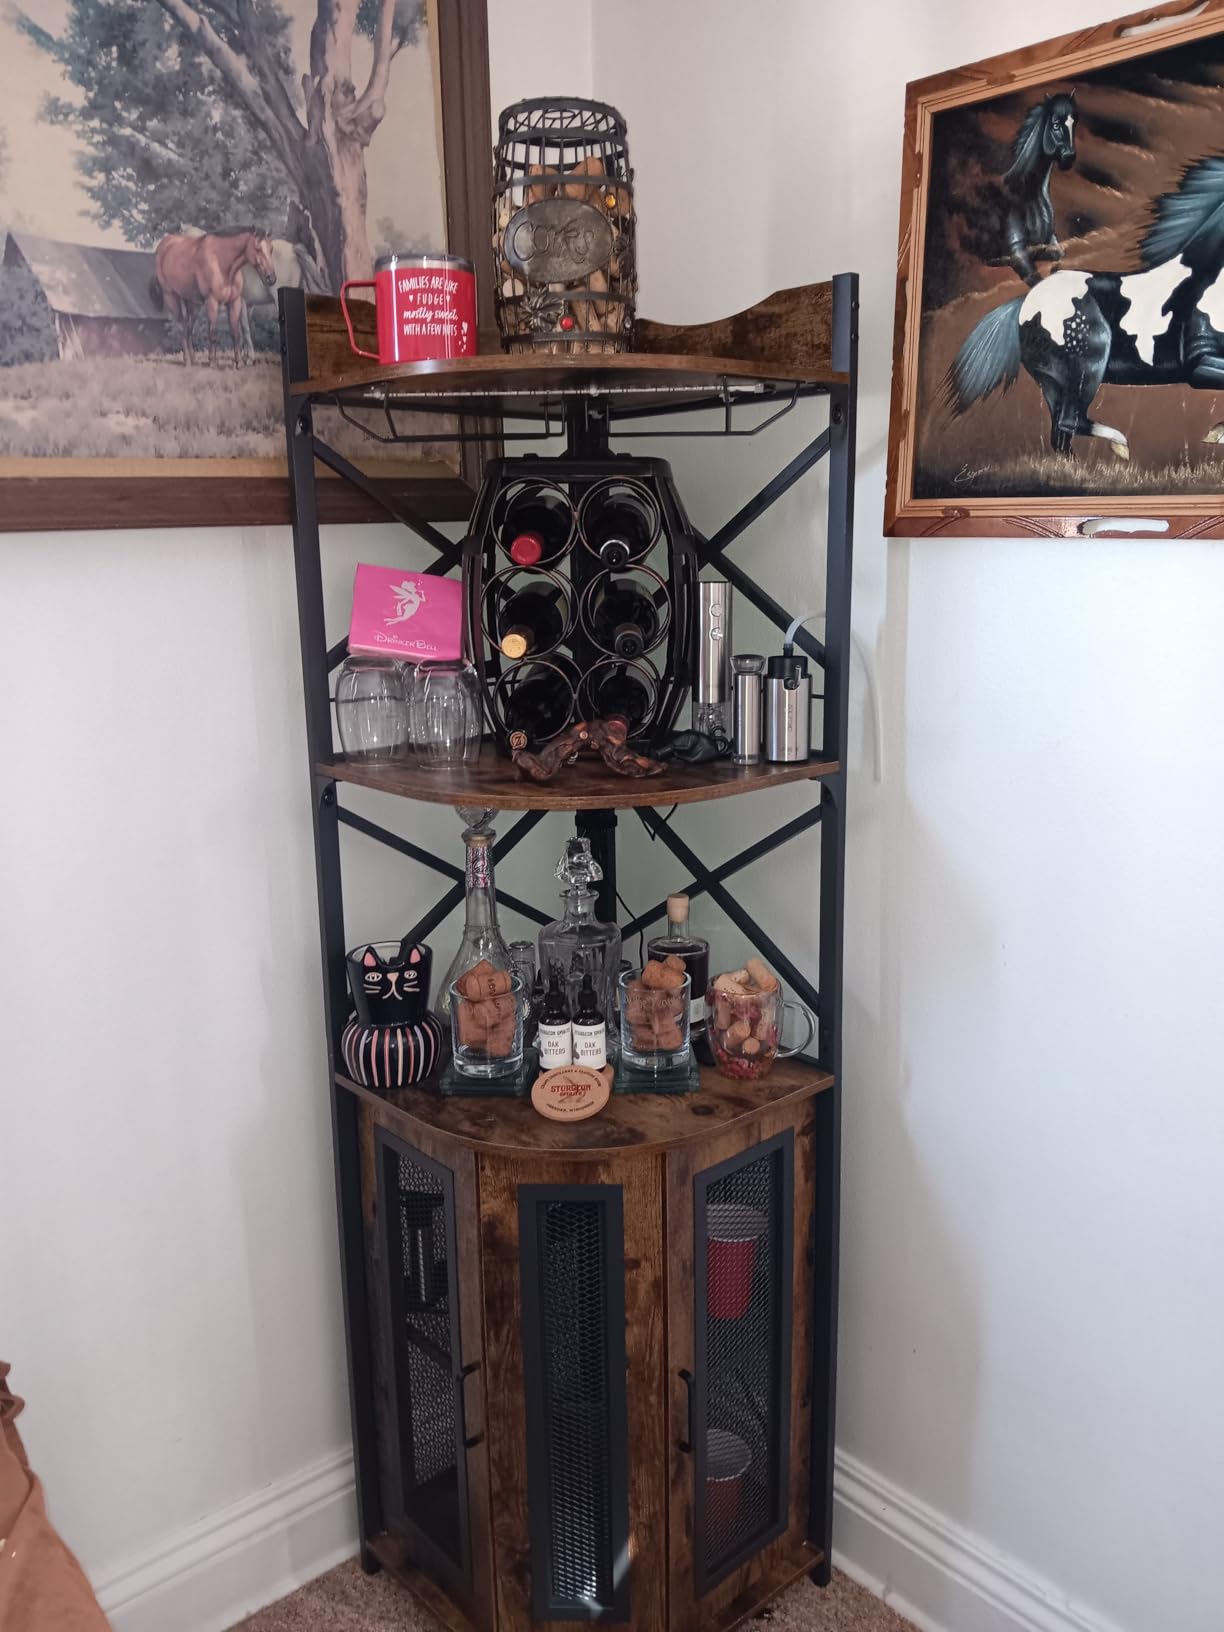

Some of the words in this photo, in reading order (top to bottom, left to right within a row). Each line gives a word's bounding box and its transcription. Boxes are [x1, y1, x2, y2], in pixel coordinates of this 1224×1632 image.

[398, 276, 430, 294] FAMILIES
[431, 276, 443, 289] ARE
[444, 279, 458, 294] LIKE
[417, 293, 443, 305] FUDGE
[403, 307, 433, 322] mostly
[403, 323, 420, 336] WITH
[421, 323, 426, 336] A
[427, 323, 441, 335] FEW
[442, 324, 457, 336] NUTS
[544, 1048, 565, 1056] BITTERS
[581, 1048, 602, 1057] BITTERS
[551, 1084, 592, 1093] STURGEON
